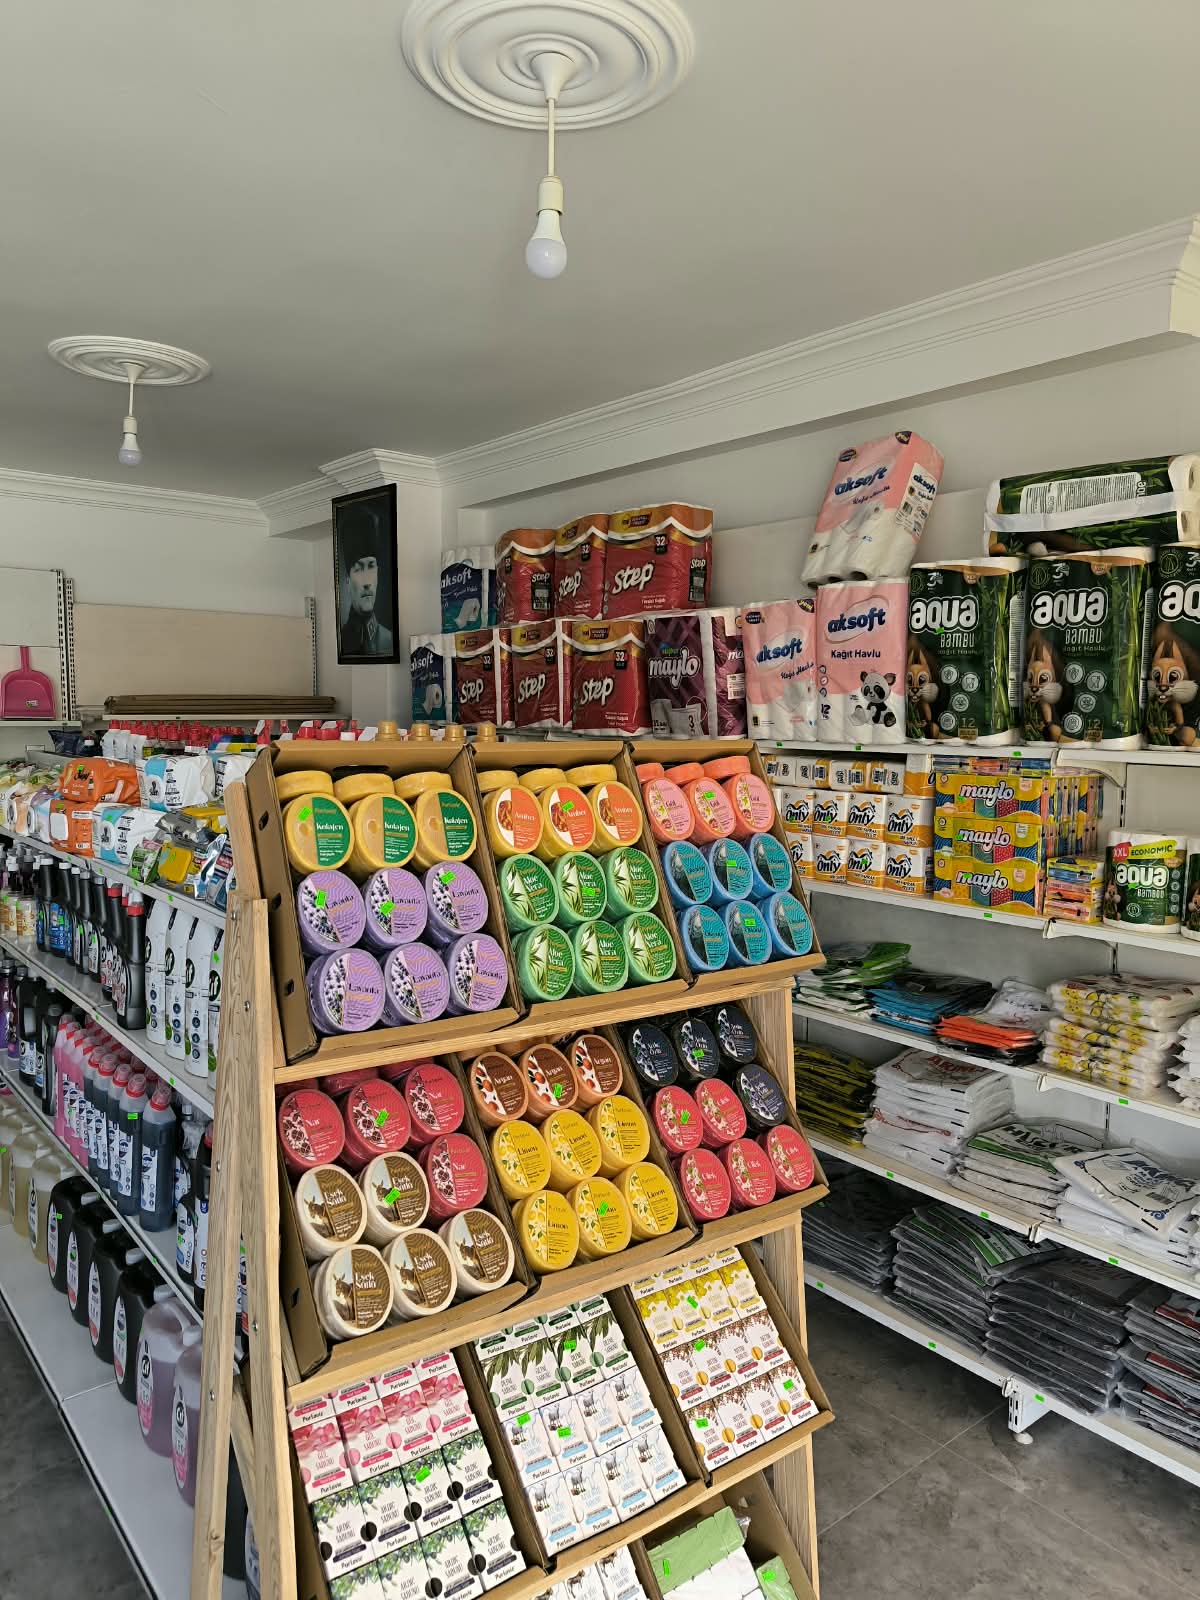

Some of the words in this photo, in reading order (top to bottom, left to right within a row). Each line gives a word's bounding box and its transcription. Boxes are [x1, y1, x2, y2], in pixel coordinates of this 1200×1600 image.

[834, 466, 888, 496] aksoft
[656, 536, 665, 546] 32
[582, 544, 590, 554] 32
[690, 558, 706, 569] Step
[532, 572, 550, 583] Step
[612, 562, 654, 594] Step
[559, 569, 582, 598] Step
[1033, 590, 1105, 626] aqua
[1160, 584, 1200, 622] aq
[910, 597, 978, 632] aqua
[828, 607, 886, 633] aksoft
[546, 648, 554, 657] 32
[756, 638, 802, 663] aksoft
[831, 650, 852, 660] Kağıt
[855, 650, 881, 658] Havlu
[484, 656, 491, 664] 32
[615, 652, 625, 662] 32
[650, 648, 699, 688] maylo
[460, 678, 484, 704] Step
[518, 673, 546, 703] Step
[580, 676, 613, 706] Step
[821, 704, 831, 714] 12
[960, 780, 1014, 806] maylo
[850, 809, 875, 825] Only
[316, 822, 344, 831] Kolajen
[384, 822, 410, 832] Kolajen
[888, 818, 913, 834] Only
[958, 826, 1010, 852] maylo
[1113, 848, 1128, 858] XXL
[1131, 844, 1173, 856] ECONOMIC
[817, 859, 841, 873] Only
[579, 872, 593, 880] Aloe
[630, 872, 646, 880] Vera
[887, 864, 912, 879] Only
[1116, 864, 1167, 888] aqua
[523, 875, 538, 885] Aloe
[580, 879, 597, 887] Vera
[956, 869, 1008, 895] maylo
[526, 882, 543, 892] Vera
[644, 932, 658, 940] Aloe
[599, 940, 614, 948] Aloe
[646, 939, 662, 948] Vera
[549, 949, 563, 958] Aloe
[600, 948, 616, 956] Vera
[593, 1057, 612, 1065] Argan
[494, 1075, 513, 1085] Argan
[569, 1134, 587, 1144] Limon
[517, 1146, 538, 1156] Limon
[647, 1190, 666, 1199] Limon
